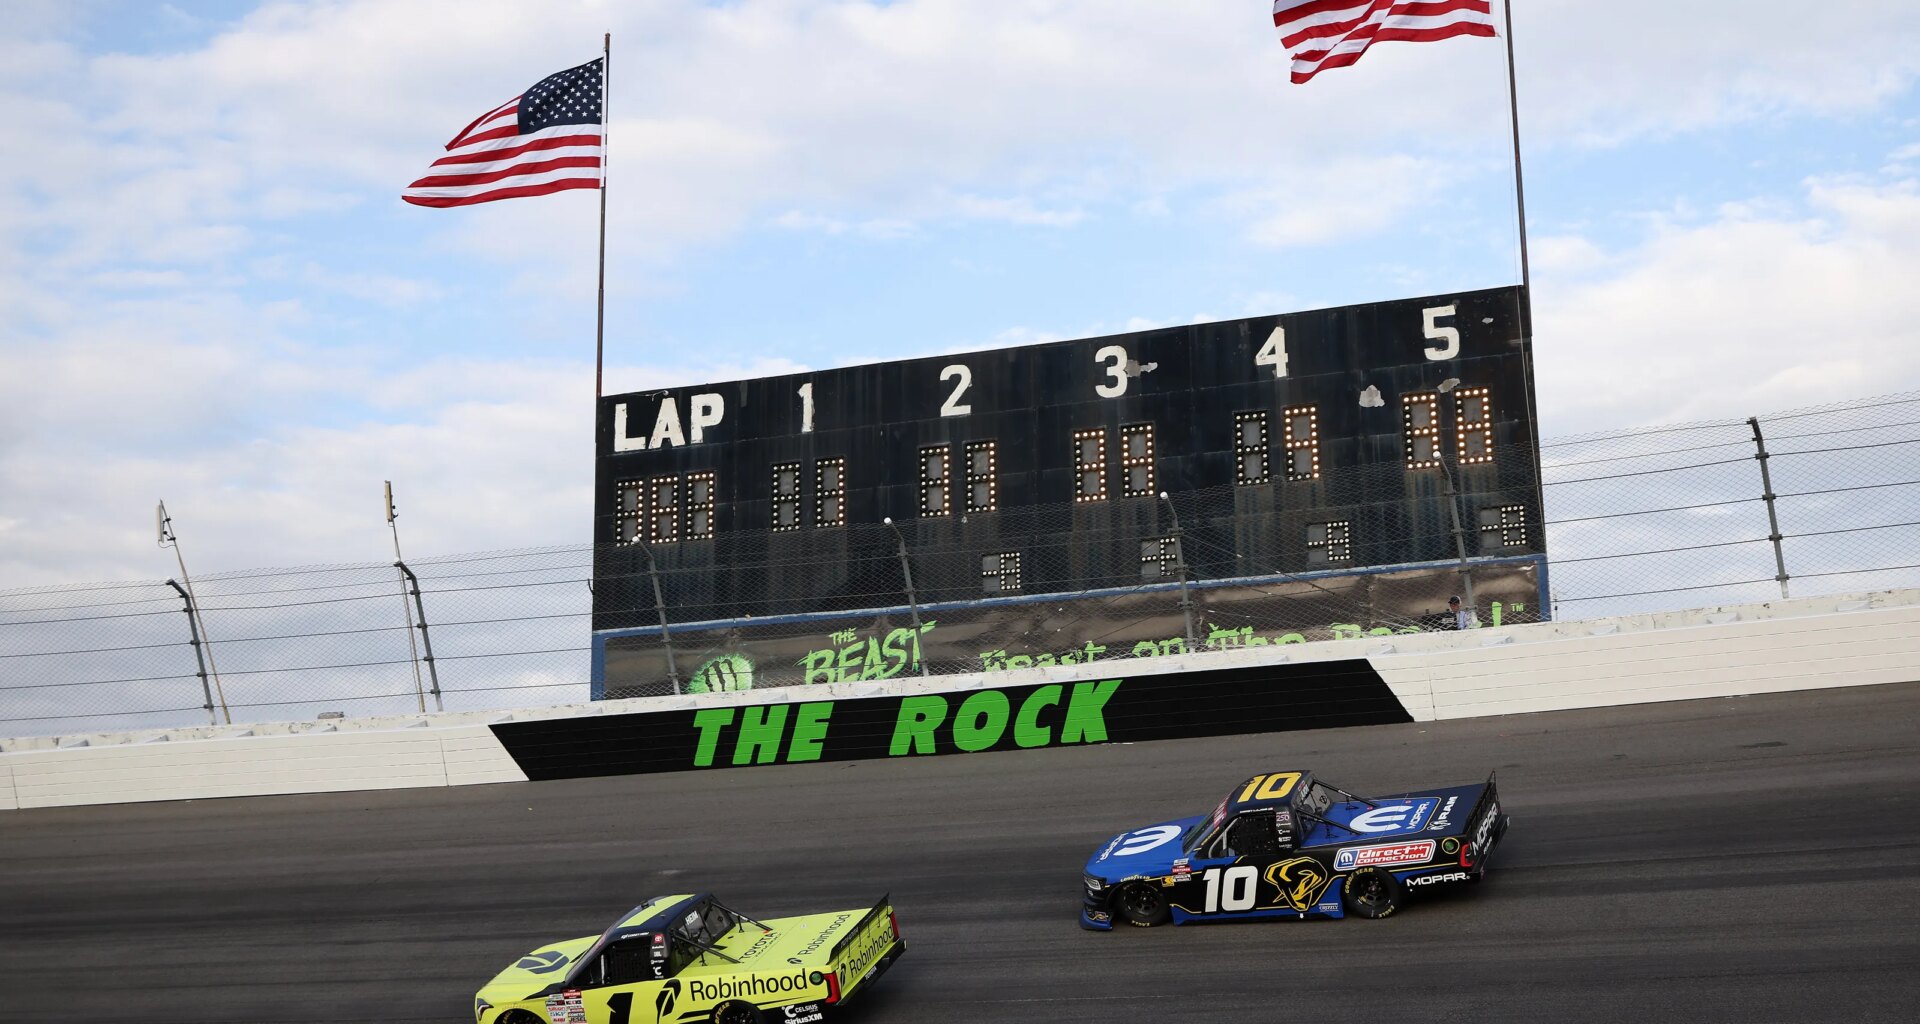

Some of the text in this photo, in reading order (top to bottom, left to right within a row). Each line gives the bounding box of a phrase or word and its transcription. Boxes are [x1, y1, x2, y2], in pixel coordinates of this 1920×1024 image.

[614, 305, 1460, 452] LAP 1 2 3 4 5
[828, 628, 858, 645] THE
[793, 620, 936, 685] BEAST
[693, 680, 1123, 766] THE ROCK
[1237, 772, 1302, 803] 10
[1406, 802, 1429, 830] MOPAR
[1438, 796, 1458, 821] RAM
[1472, 802, 1498, 856] MOPAR
[1356, 853, 1426, 864] connection
[1202, 864, 1259, 914] 10
[1406, 872, 1466, 887] MOPAR
[685, 910, 699, 925] HEIM
[738, 932, 778, 963] TOYOTA
[797, 913, 850, 955] Robinhood
[849, 917, 895, 978] Robinhood
[690, 968, 808, 1002] Robinhood
[784, 1012, 823, 1024] SiriusXM
[795, 1003, 818, 1013] CELSIUS
